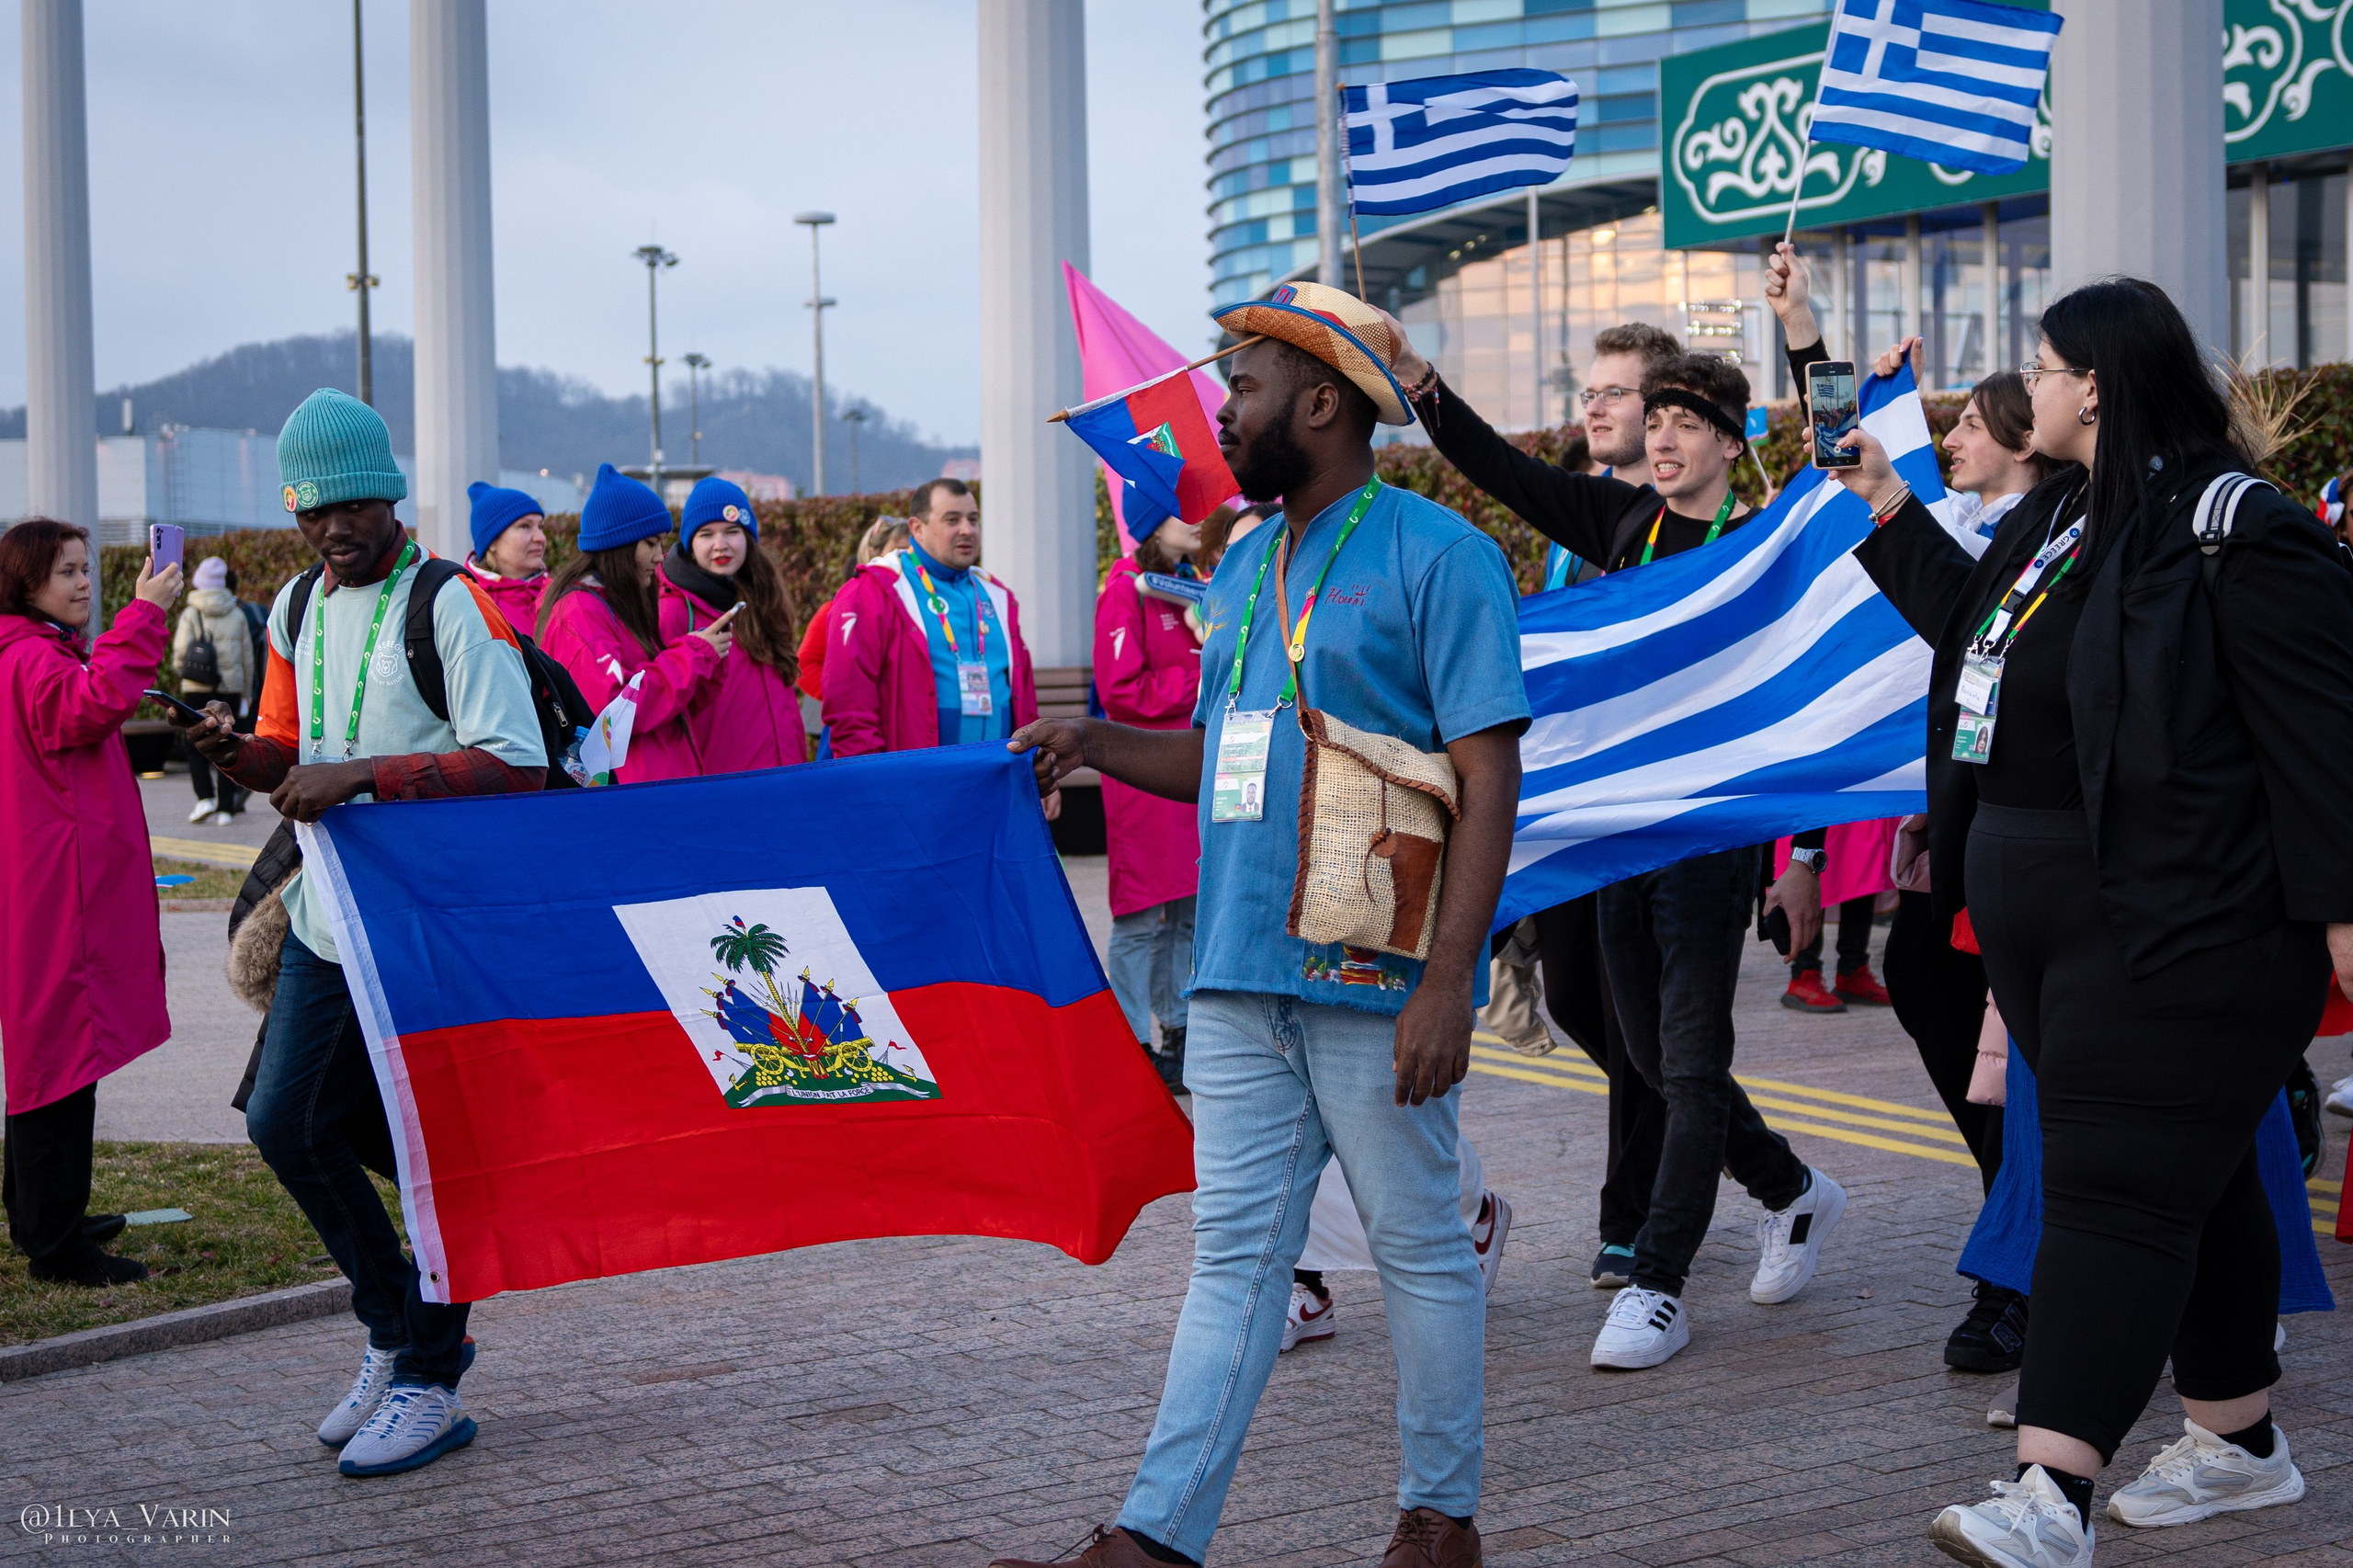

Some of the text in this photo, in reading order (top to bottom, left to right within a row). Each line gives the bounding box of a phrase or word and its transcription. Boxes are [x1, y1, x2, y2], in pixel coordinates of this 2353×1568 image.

[2042, 535, 2070, 561] GREECE
[377, 640, 404, 653] BEREGI
[791, 1090, 821, 1098] L'UNION
[847, 1086, 871, 1096] FORCE
